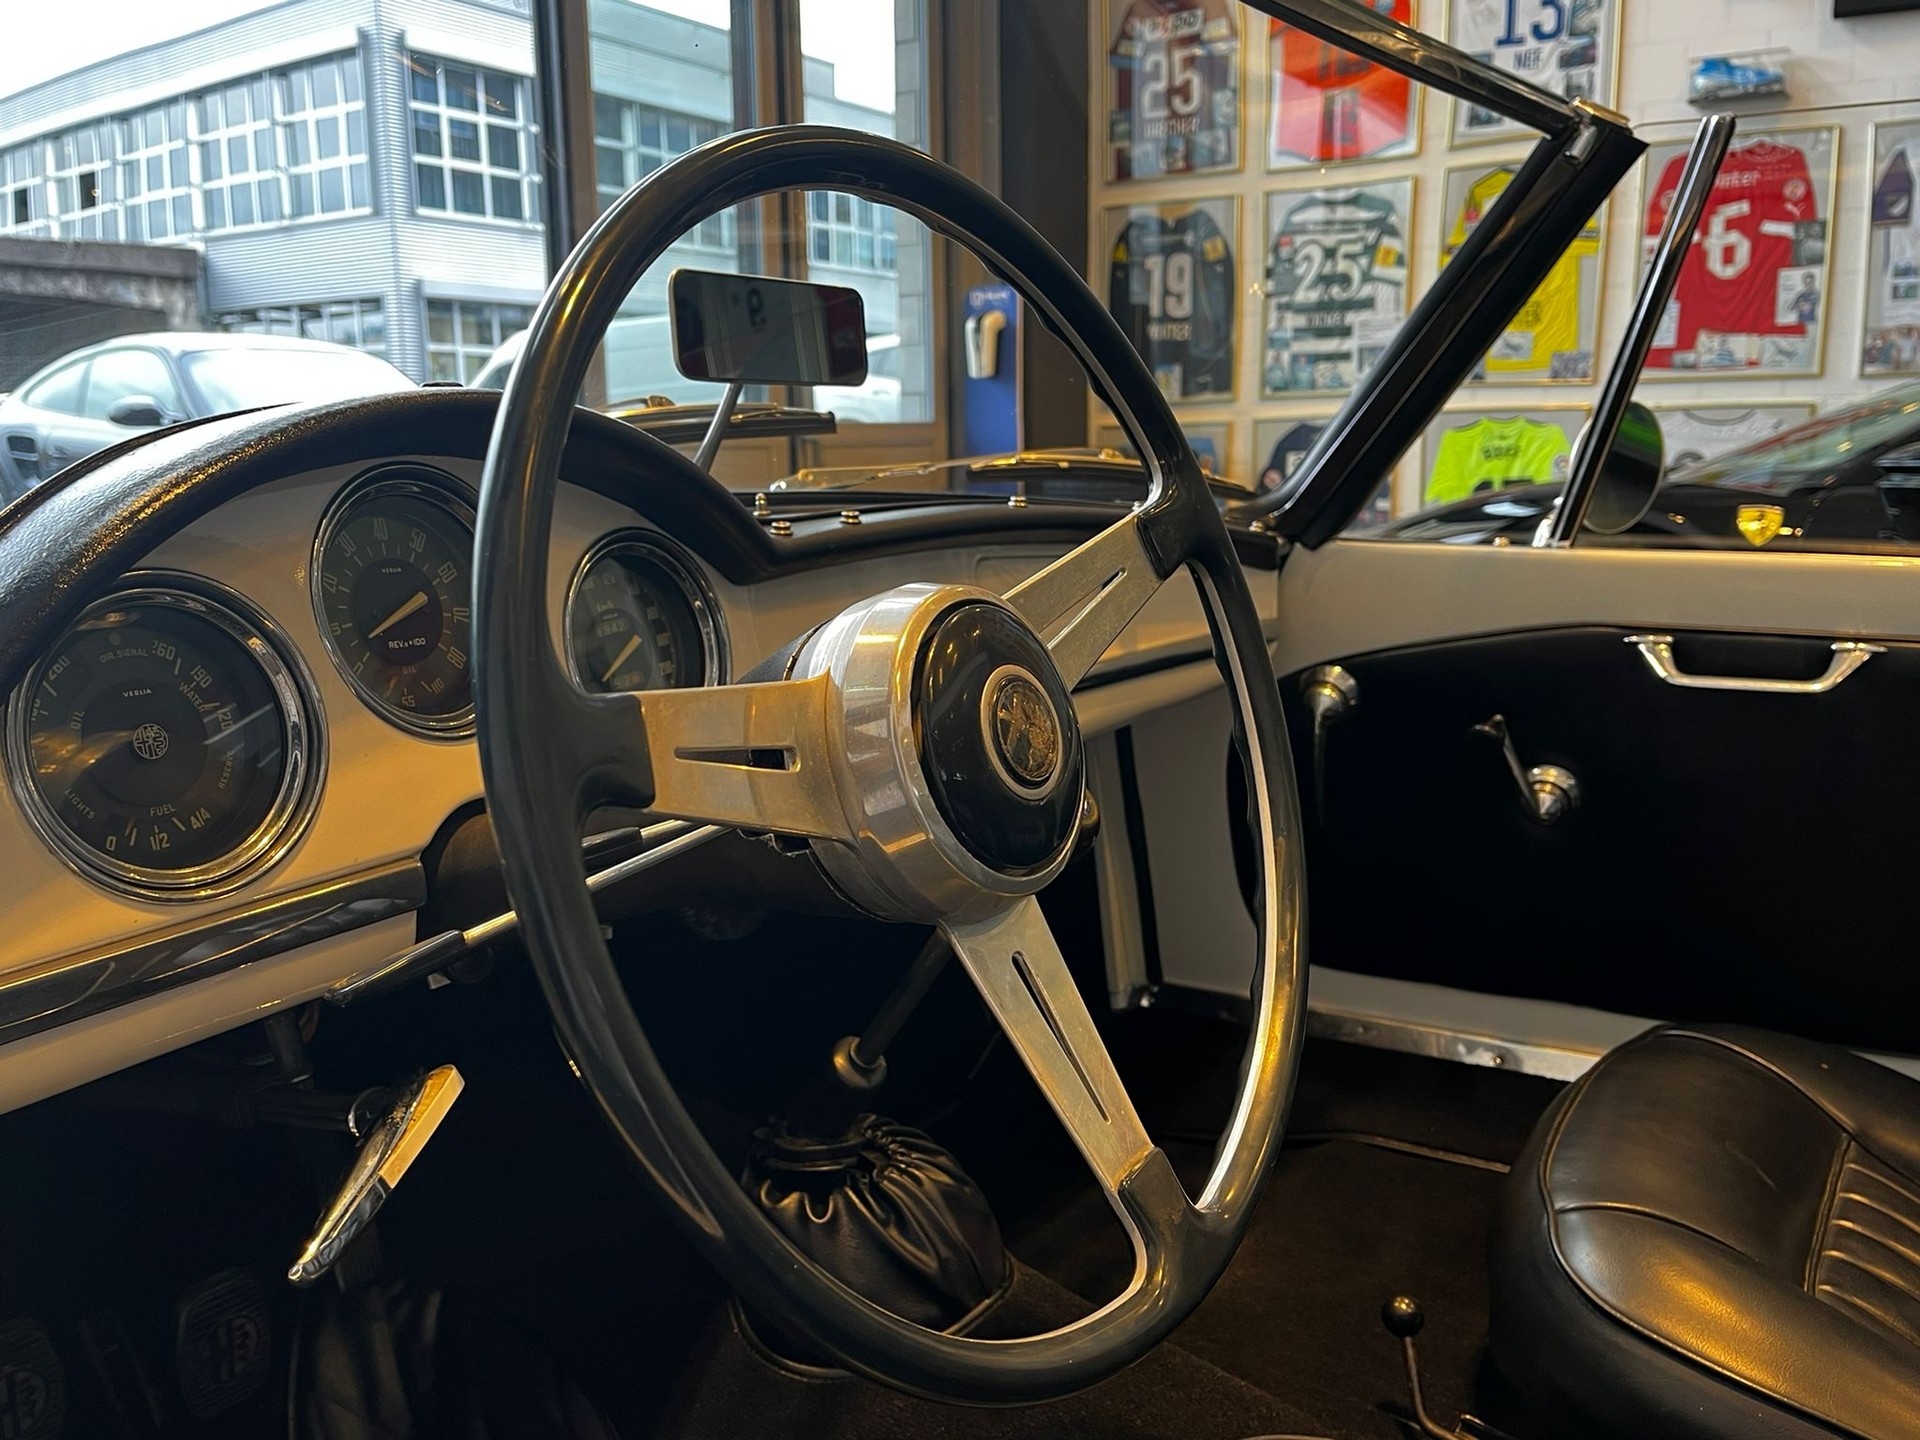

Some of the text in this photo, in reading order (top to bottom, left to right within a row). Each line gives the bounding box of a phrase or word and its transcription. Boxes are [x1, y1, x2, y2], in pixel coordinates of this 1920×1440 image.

[1141, 47, 1202, 119] 25
[1705, 199, 1751, 280] 6
[1290, 237, 1366, 304] 25
[1143, 252, 1194, 319] 19
[373, 517, 388, 541] 40
[409, 527, 426, 553] 50
[437, 561, 457, 584] 60
[452, 607, 470, 624] 70
[447, 646, 467, 670] 80
[190, 664, 213, 689] 190
[122, 688, 152, 698] VEGLIA
[179, 682, 206, 713] WATER
[70, 710, 85, 730] OIL
[64, 788, 95, 820] LIGHTS
[150, 803, 177, 817] FUEL
[105, 835, 117, 852] 0
